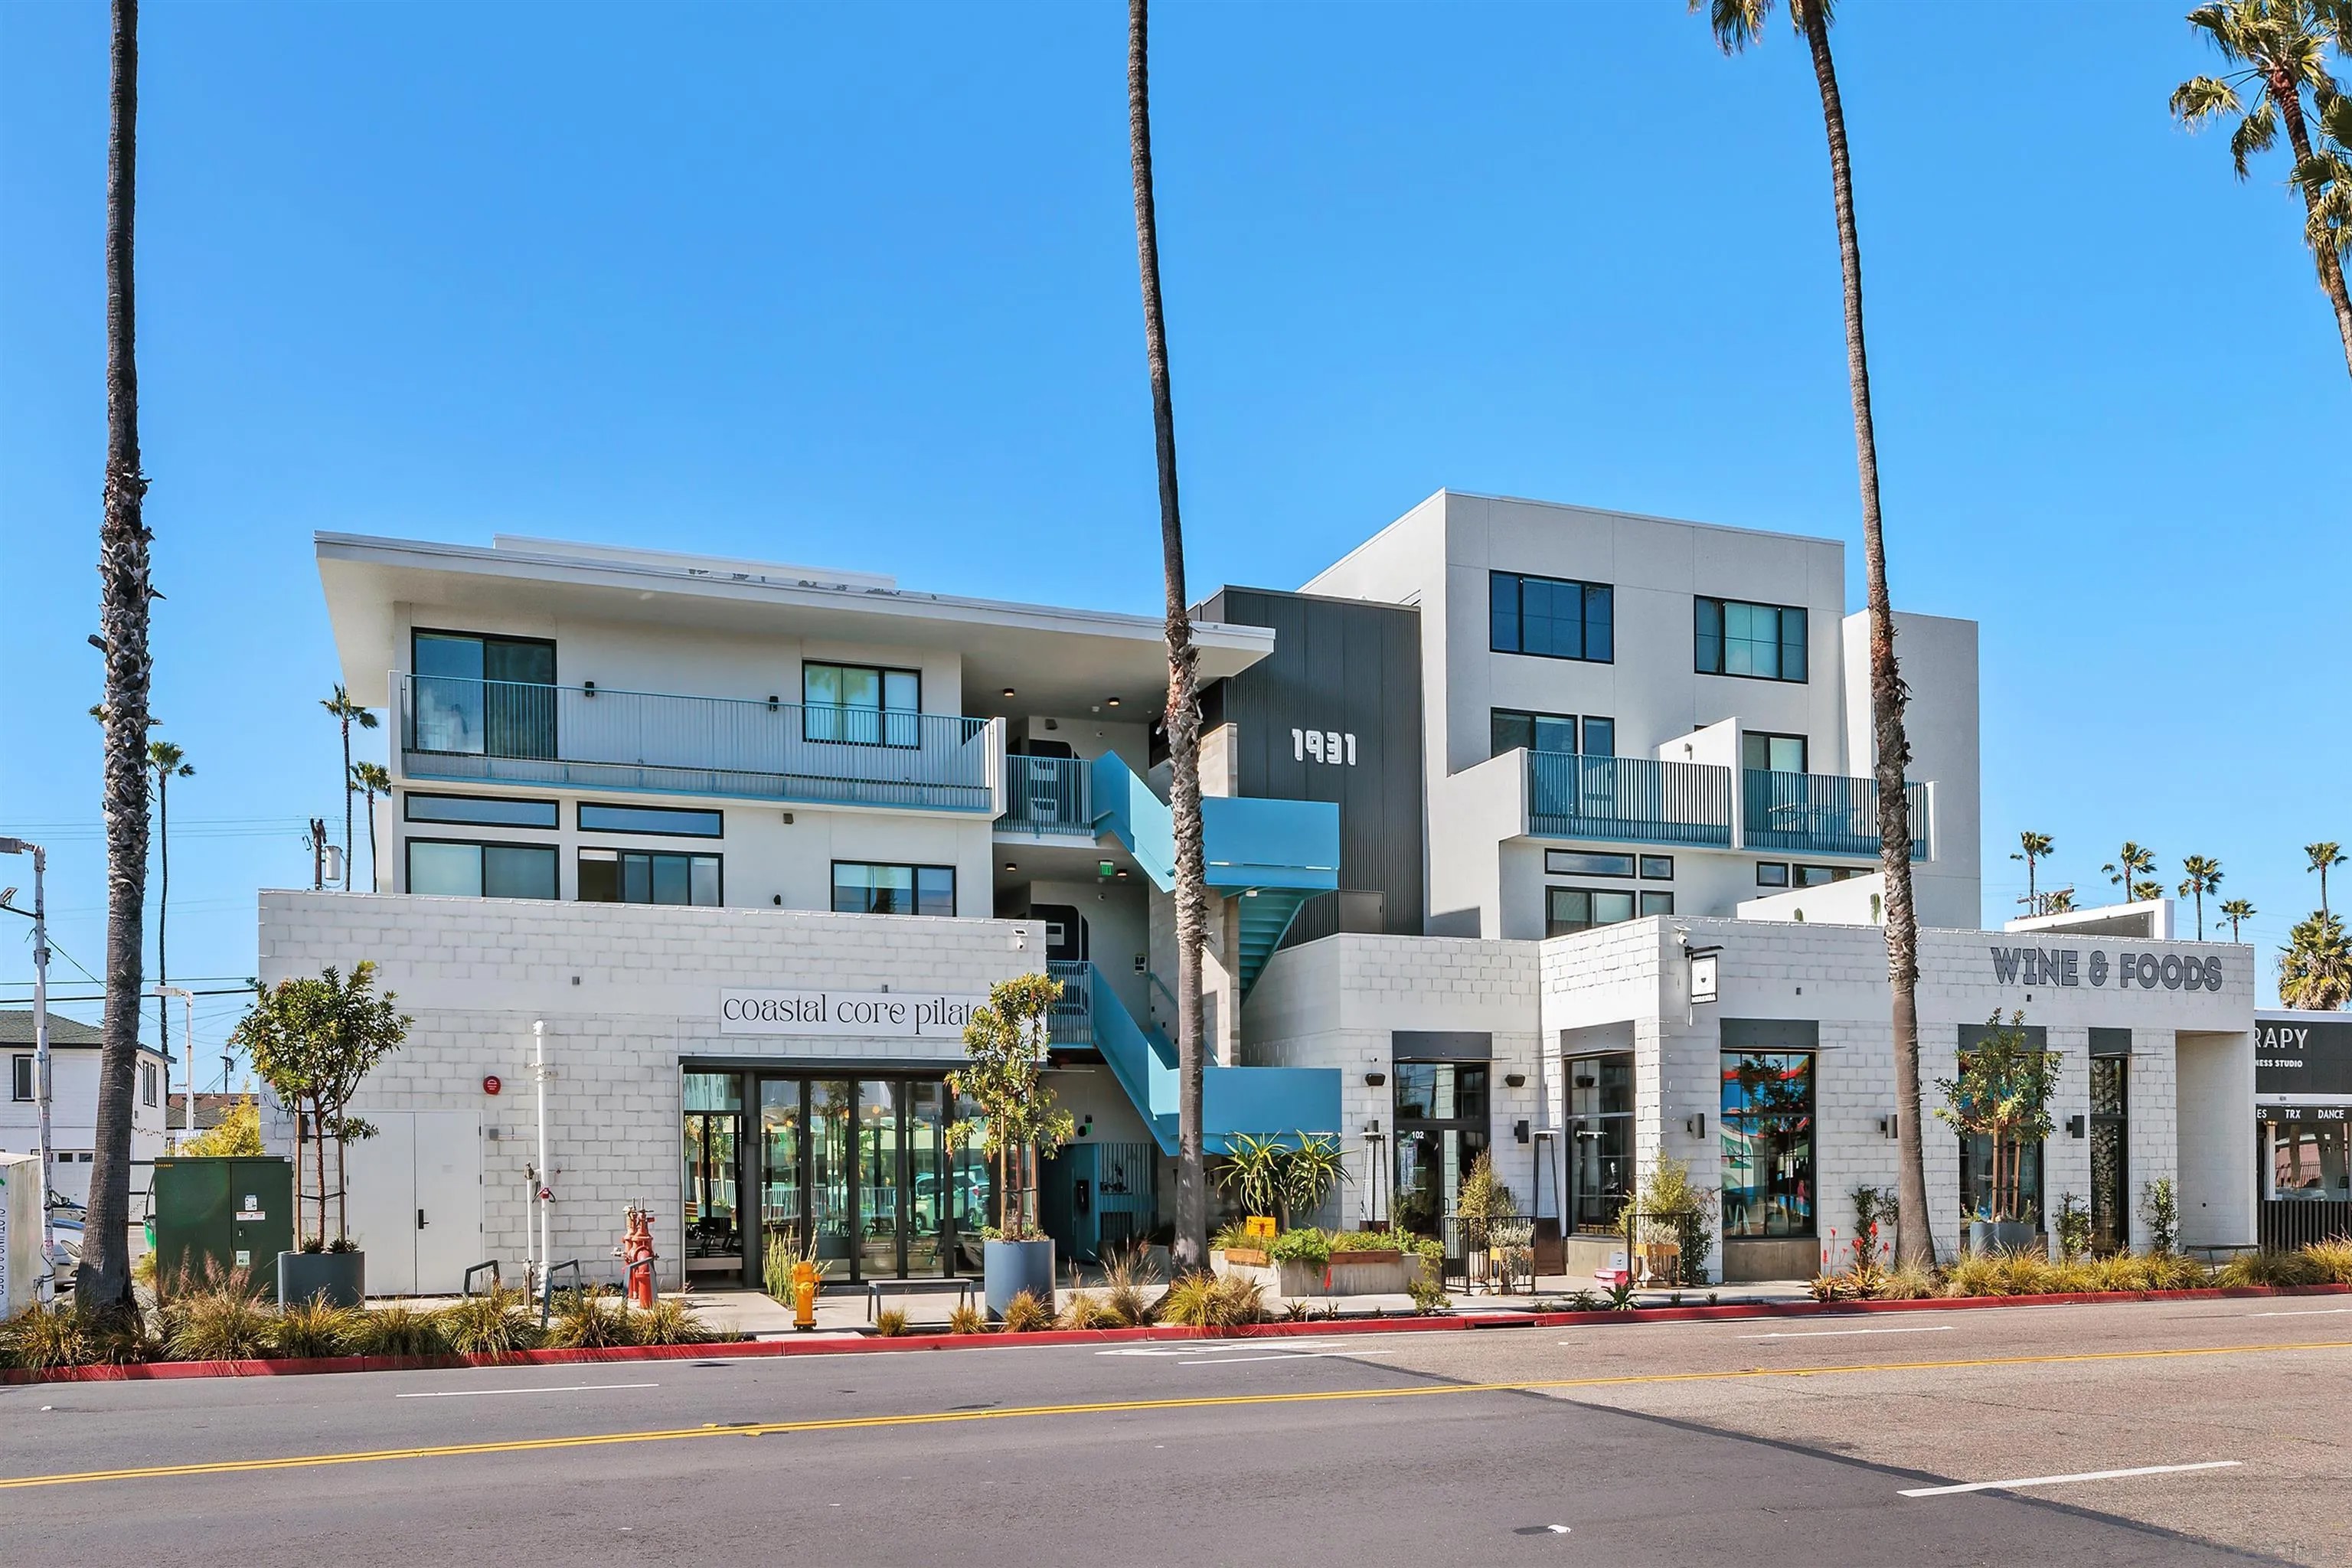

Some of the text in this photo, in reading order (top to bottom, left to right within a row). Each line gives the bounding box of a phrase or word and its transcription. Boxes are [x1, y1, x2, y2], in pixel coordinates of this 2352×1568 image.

[1292, 728, 1356, 766] 1931
[1990, 947, 2223, 991] WINE & FOODS
[724, 994, 996, 1035] coastal core pilat
[2275, 1060, 2303, 1068] STUDIO
[2285, 1109, 2301, 1119] TRX
[2318, 1109, 2344, 1119] DANCE
[1412, 1131, 1424, 1139] 102
